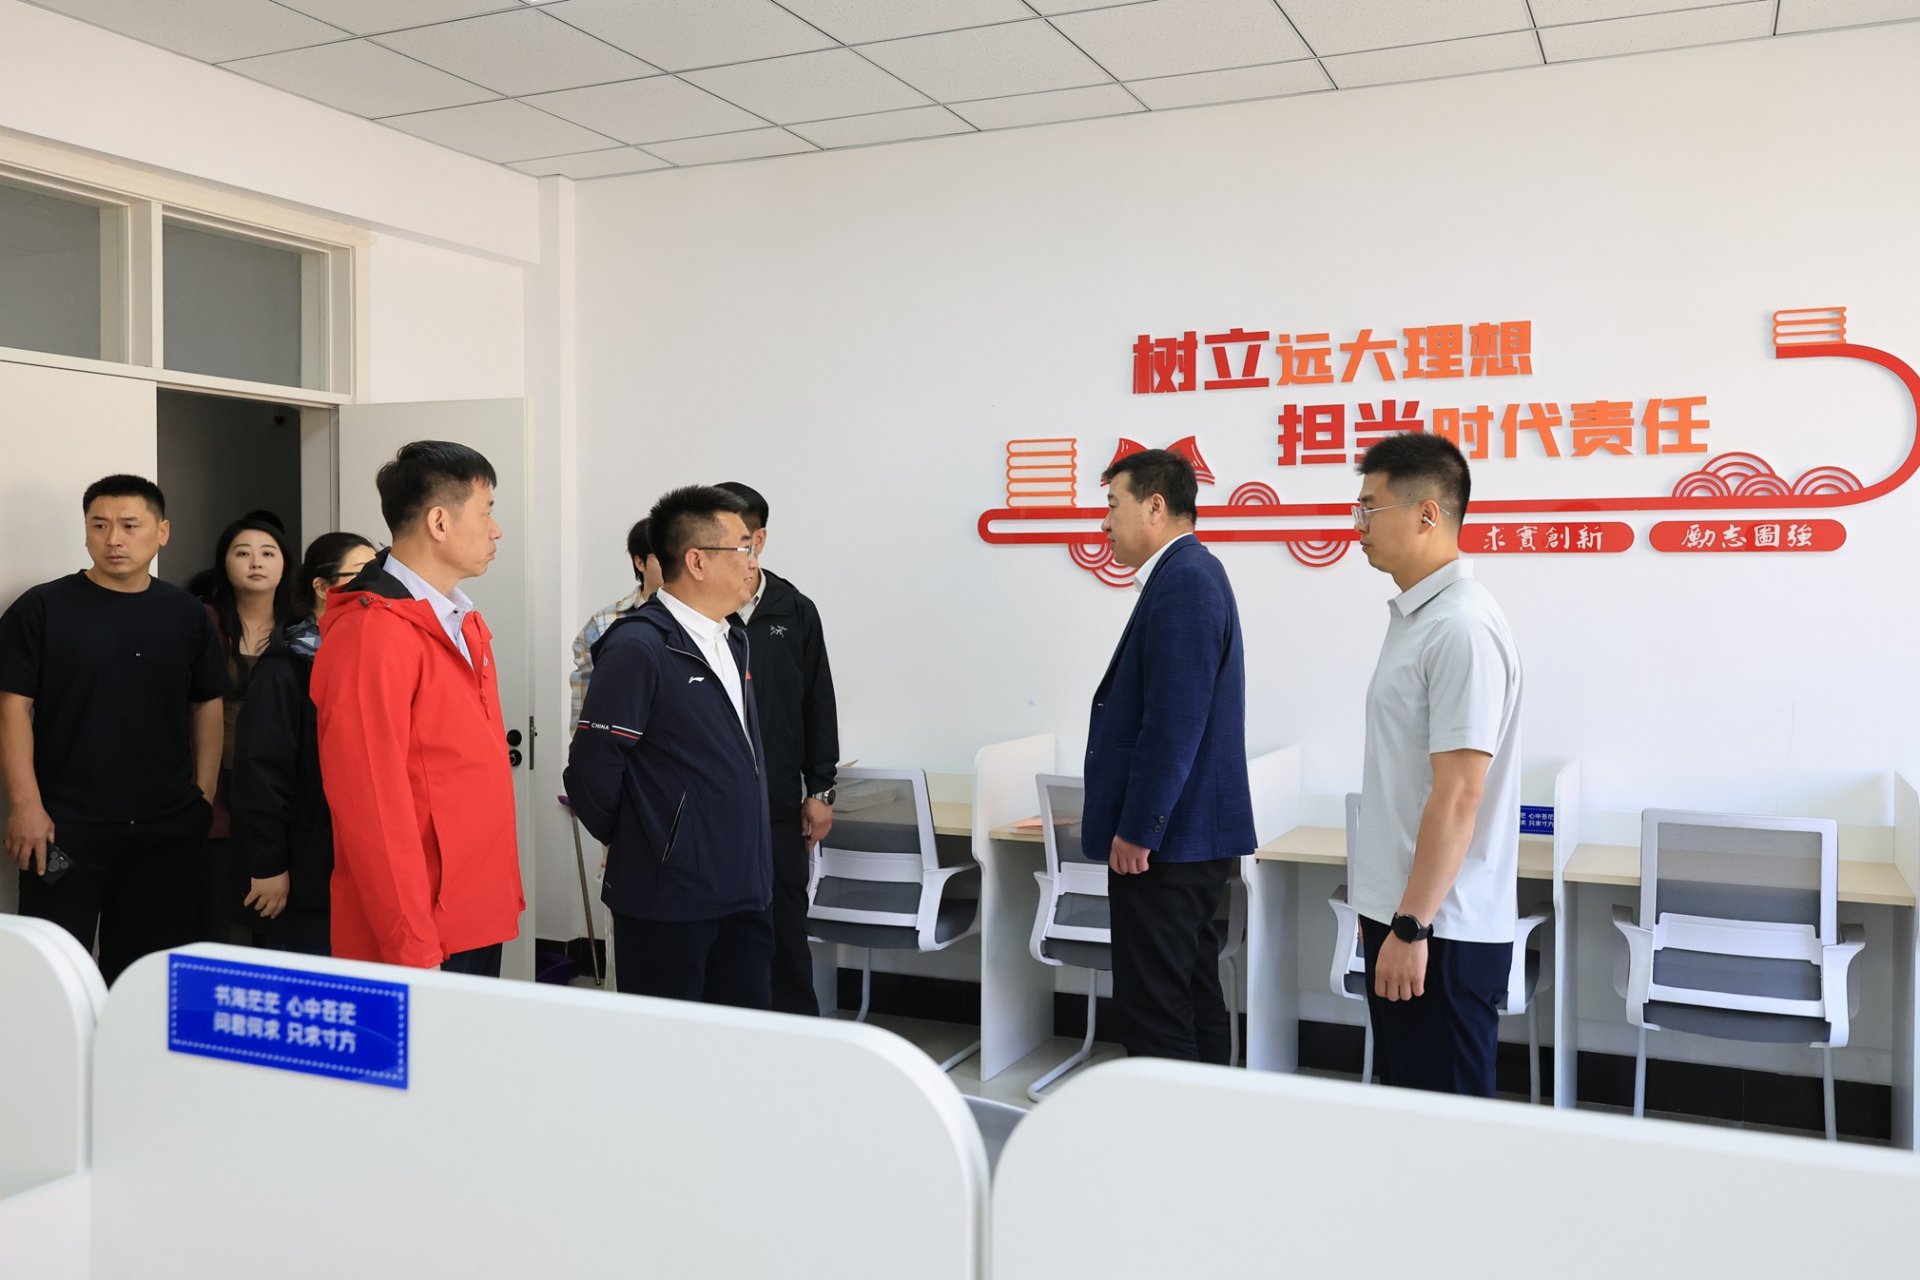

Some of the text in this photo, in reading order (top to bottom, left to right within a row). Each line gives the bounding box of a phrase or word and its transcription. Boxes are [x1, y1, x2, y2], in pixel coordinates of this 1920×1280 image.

[1132, 320, 1533, 394] 树立远大理想
[1278, 396, 1710, 465] 担当时代责任
[591, 722, 609, 730] CHINA
